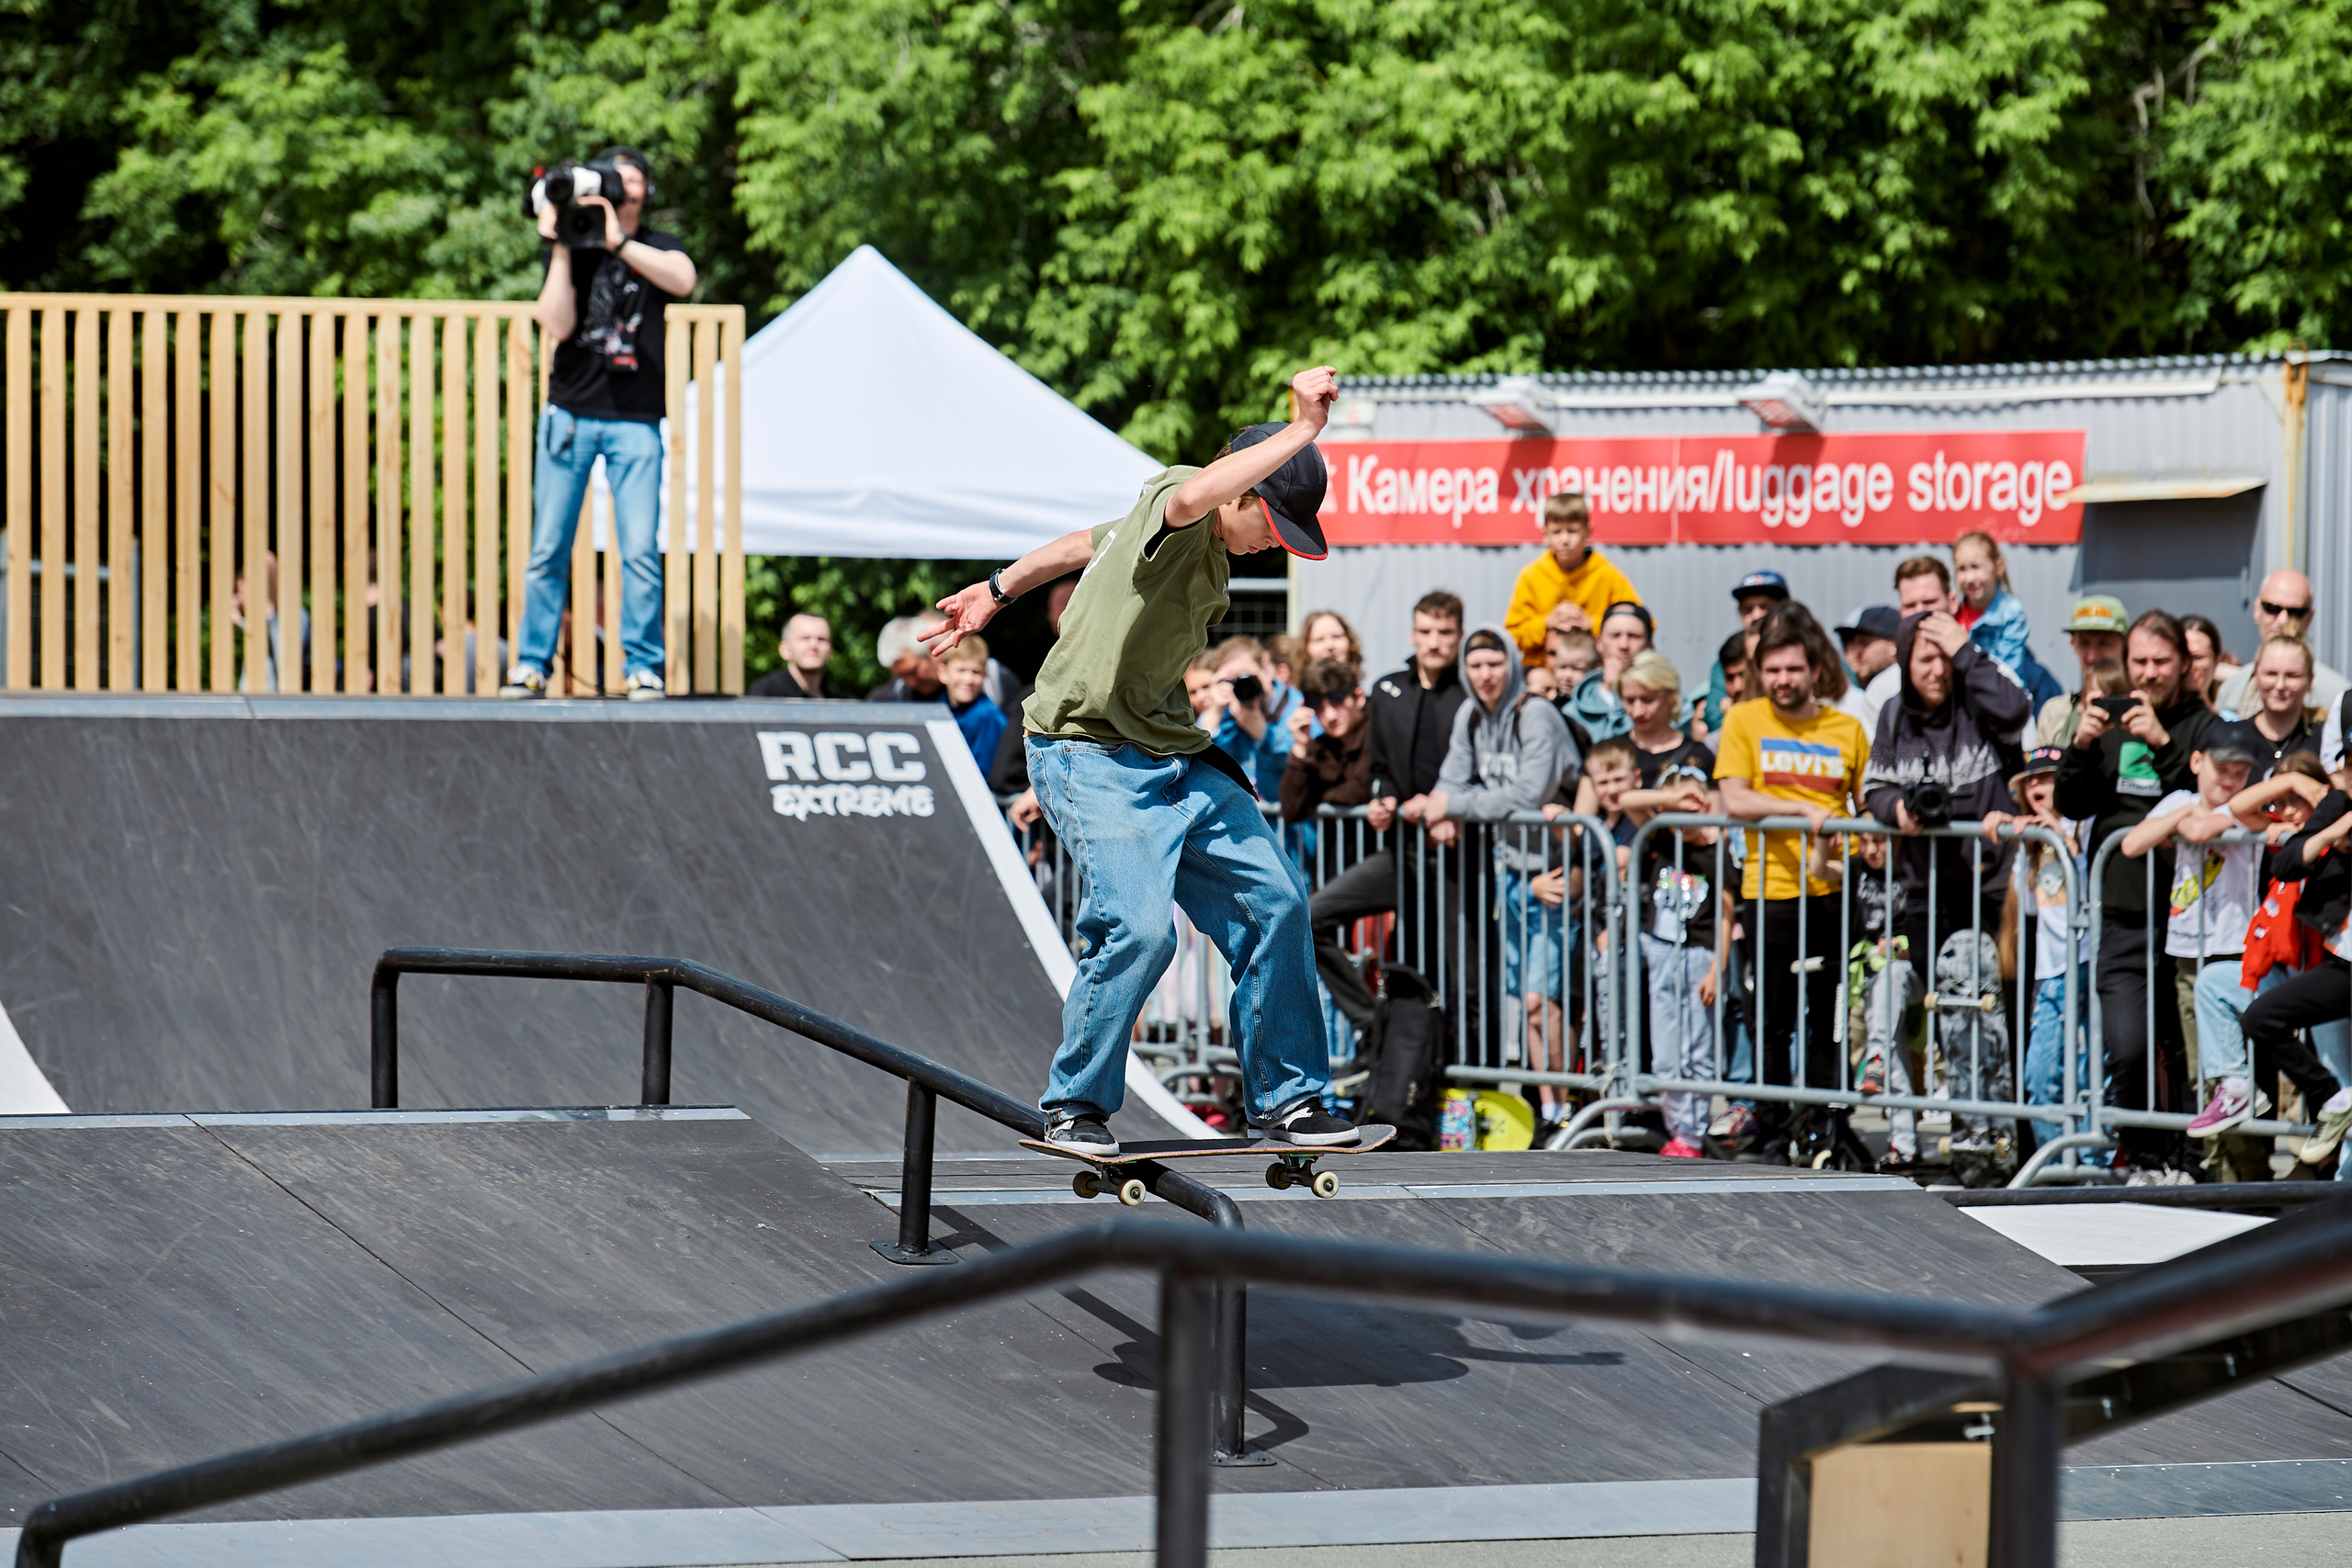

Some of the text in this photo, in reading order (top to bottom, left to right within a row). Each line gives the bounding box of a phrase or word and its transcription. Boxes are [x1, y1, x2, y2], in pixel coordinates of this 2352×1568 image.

[1346, 448, 2074, 529] Камера хранения/luggage storage
[756, 731, 927, 782] RCC
[770, 783, 935, 821] EXTREME
